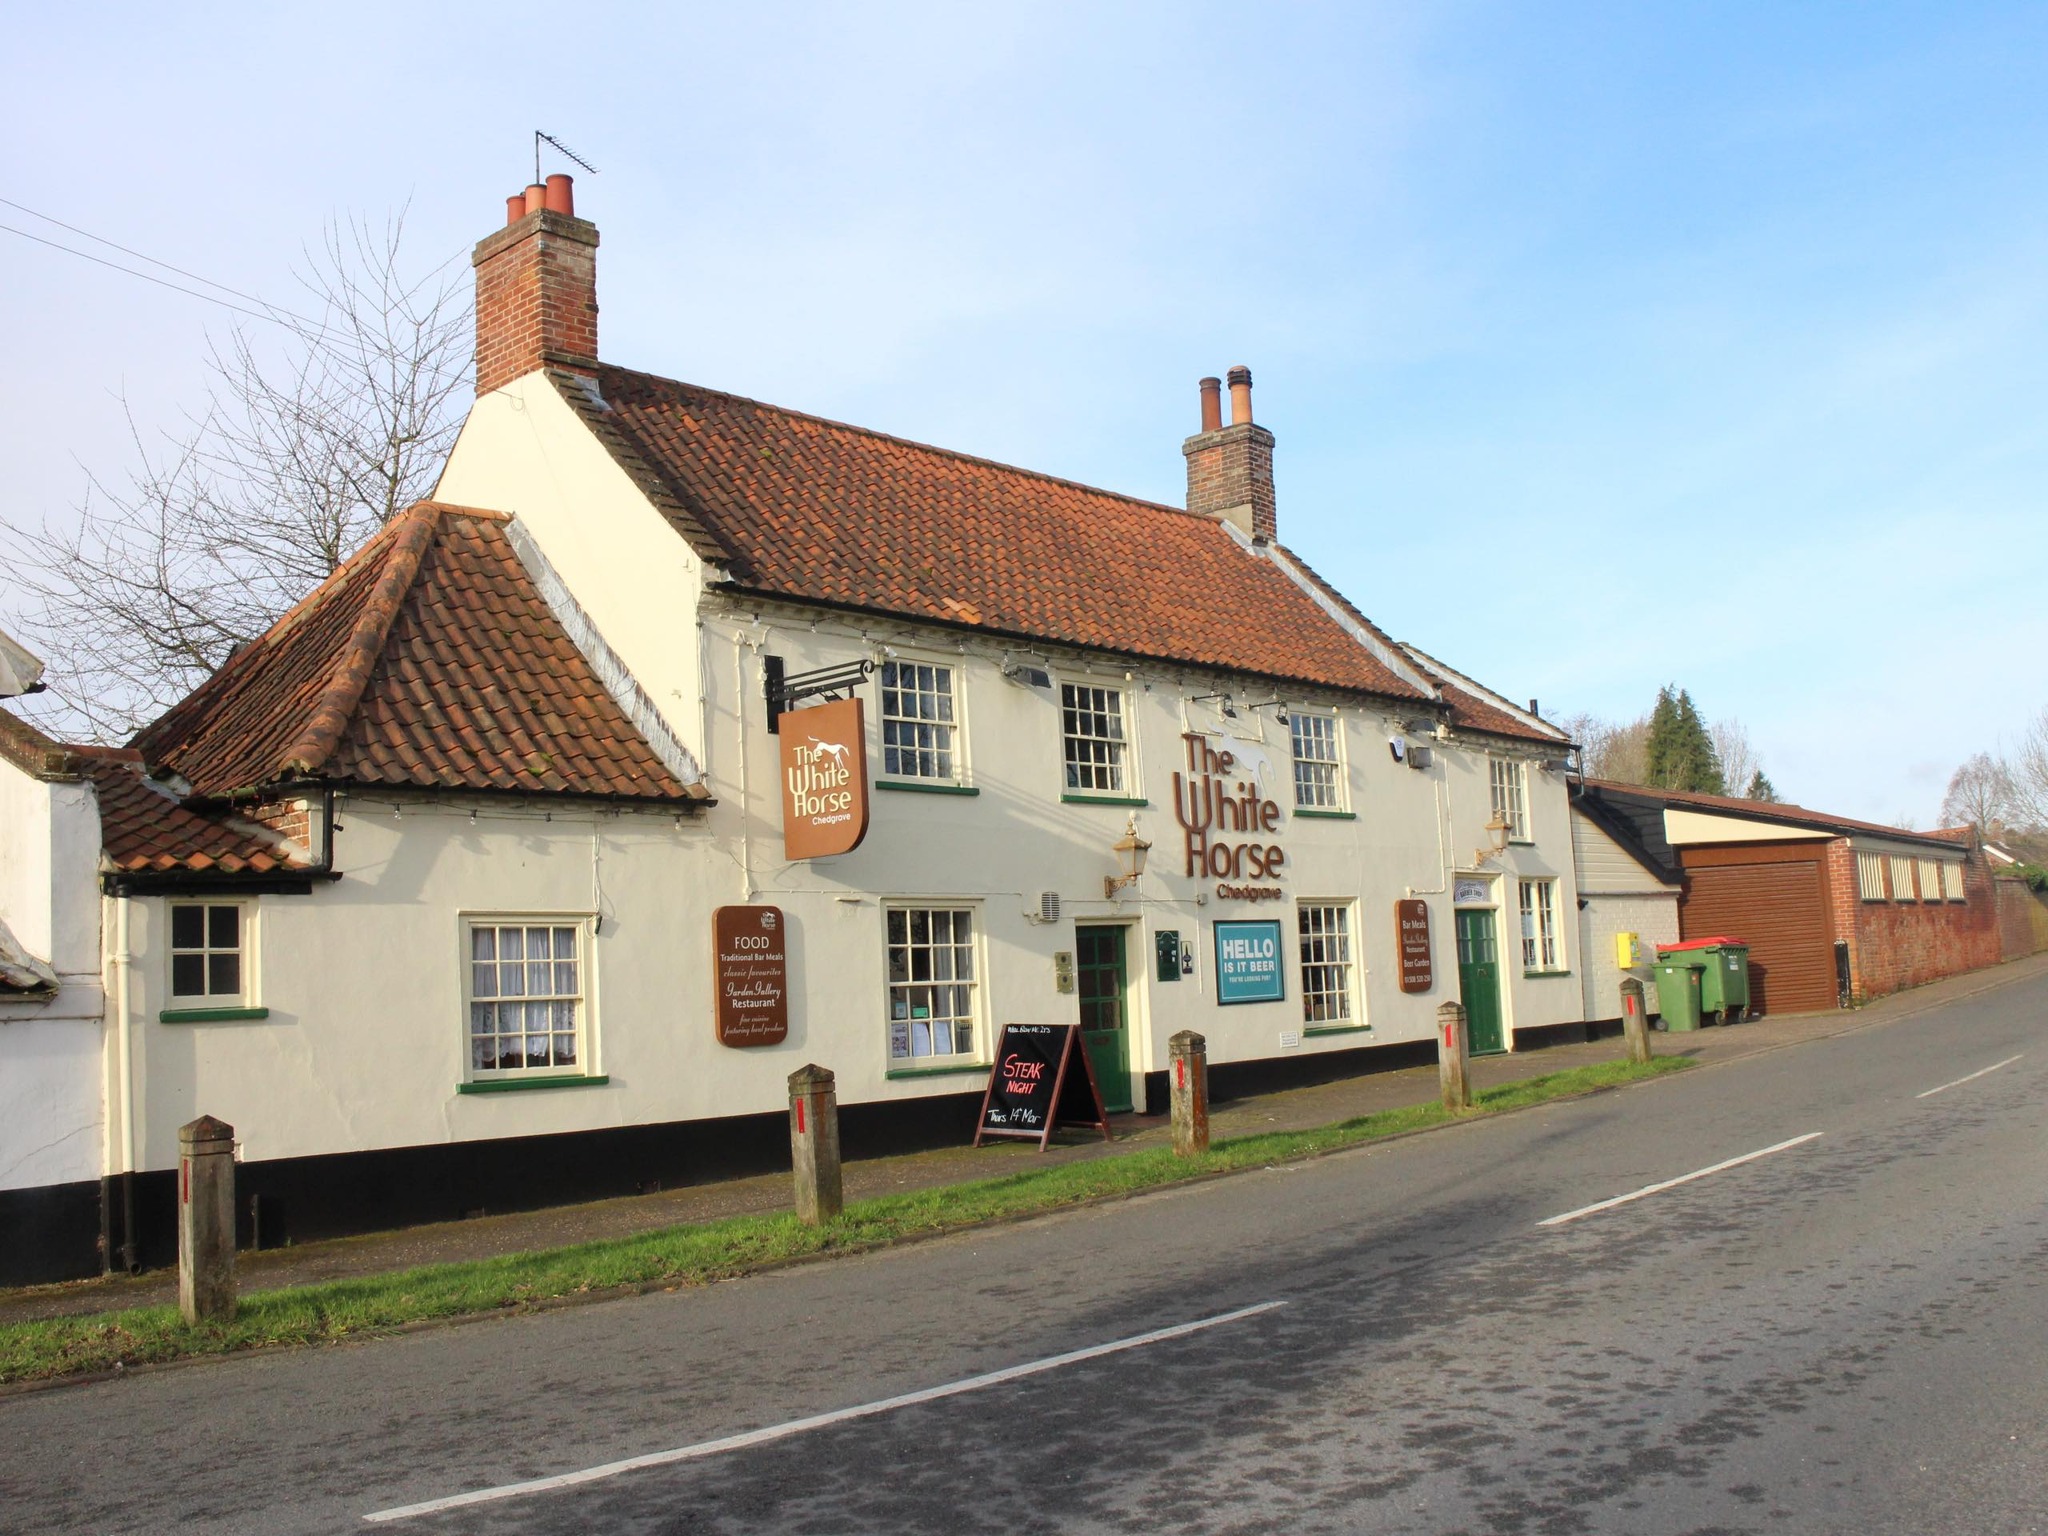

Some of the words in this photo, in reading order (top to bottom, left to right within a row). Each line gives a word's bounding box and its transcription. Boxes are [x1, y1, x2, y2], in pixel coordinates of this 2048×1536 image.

[793, 746, 822, 766] The
[1181, 733, 1234, 774] The
[788, 762, 850, 795] White
[794, 792, 852, 817] Horse
[1172, 772, 1280, 832] White
[1185, 829, 1284, 879] Horse
[1216, 883, 1283, 902] Chedgrave
[1402, 920, 1411, 929] Bar
[1411, 920, 1426, 928] Meals
[735, 936, 770, 949] FOOD
[1222, 938, 1274, 959] HELLO
[720, 953, 754, 962] Traditional
[754, 953, 765, 961] Bar
[765, 952, 784, 961] Meals
[1224, 961, 1235, 973] IS
[1237, 961, 1247, 972] IT
[1250, 960, 1275, 972] BEER
[1404, 959, 1414, 967] Beer
[1414, 958, 1430, 967] Garden
[723, 965, 747, 977] classic
[747, 964, 782, 980] favourites
[725, 981, 754, 997] Garden
[753, 980, 781, 999] Gallery
[732, 998, 776, 1009] Restaurant
[1003, 1053, 1045, 1079] STEAK
[1006, 1080, 1037, 1094] NIGHT
[987, 1109, 1007, 1122] Thurs
[1021, 1108, 1042, 1124] Mar
